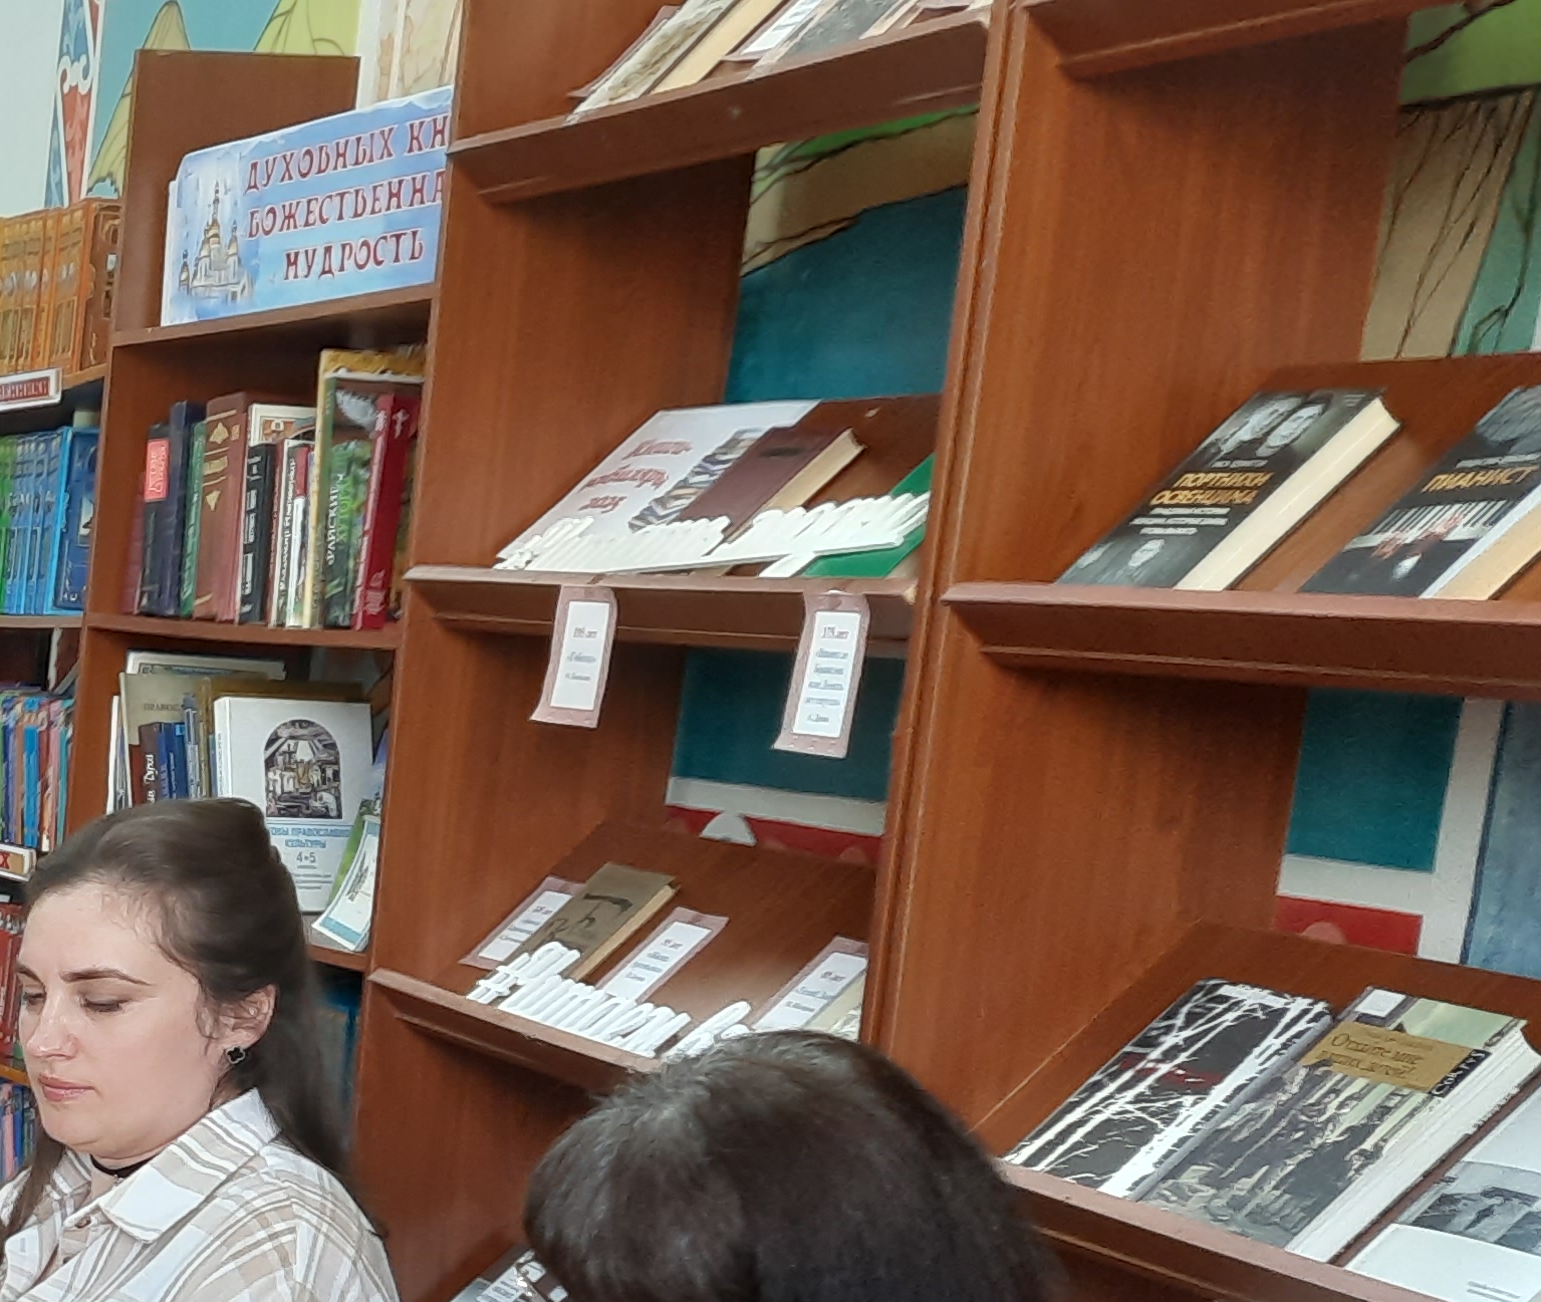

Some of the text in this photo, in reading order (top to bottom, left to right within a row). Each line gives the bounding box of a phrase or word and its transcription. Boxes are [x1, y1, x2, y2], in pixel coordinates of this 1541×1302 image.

[245, 113, 449, 195] ДУХОВНЫХ КН
[247, 170, 446, 240] БОЖЕСТВЕННА
[283, 229, 424, 282] МУДРОСТЬ
[1420, 464, 1541, 494] ПИАНИСТ
